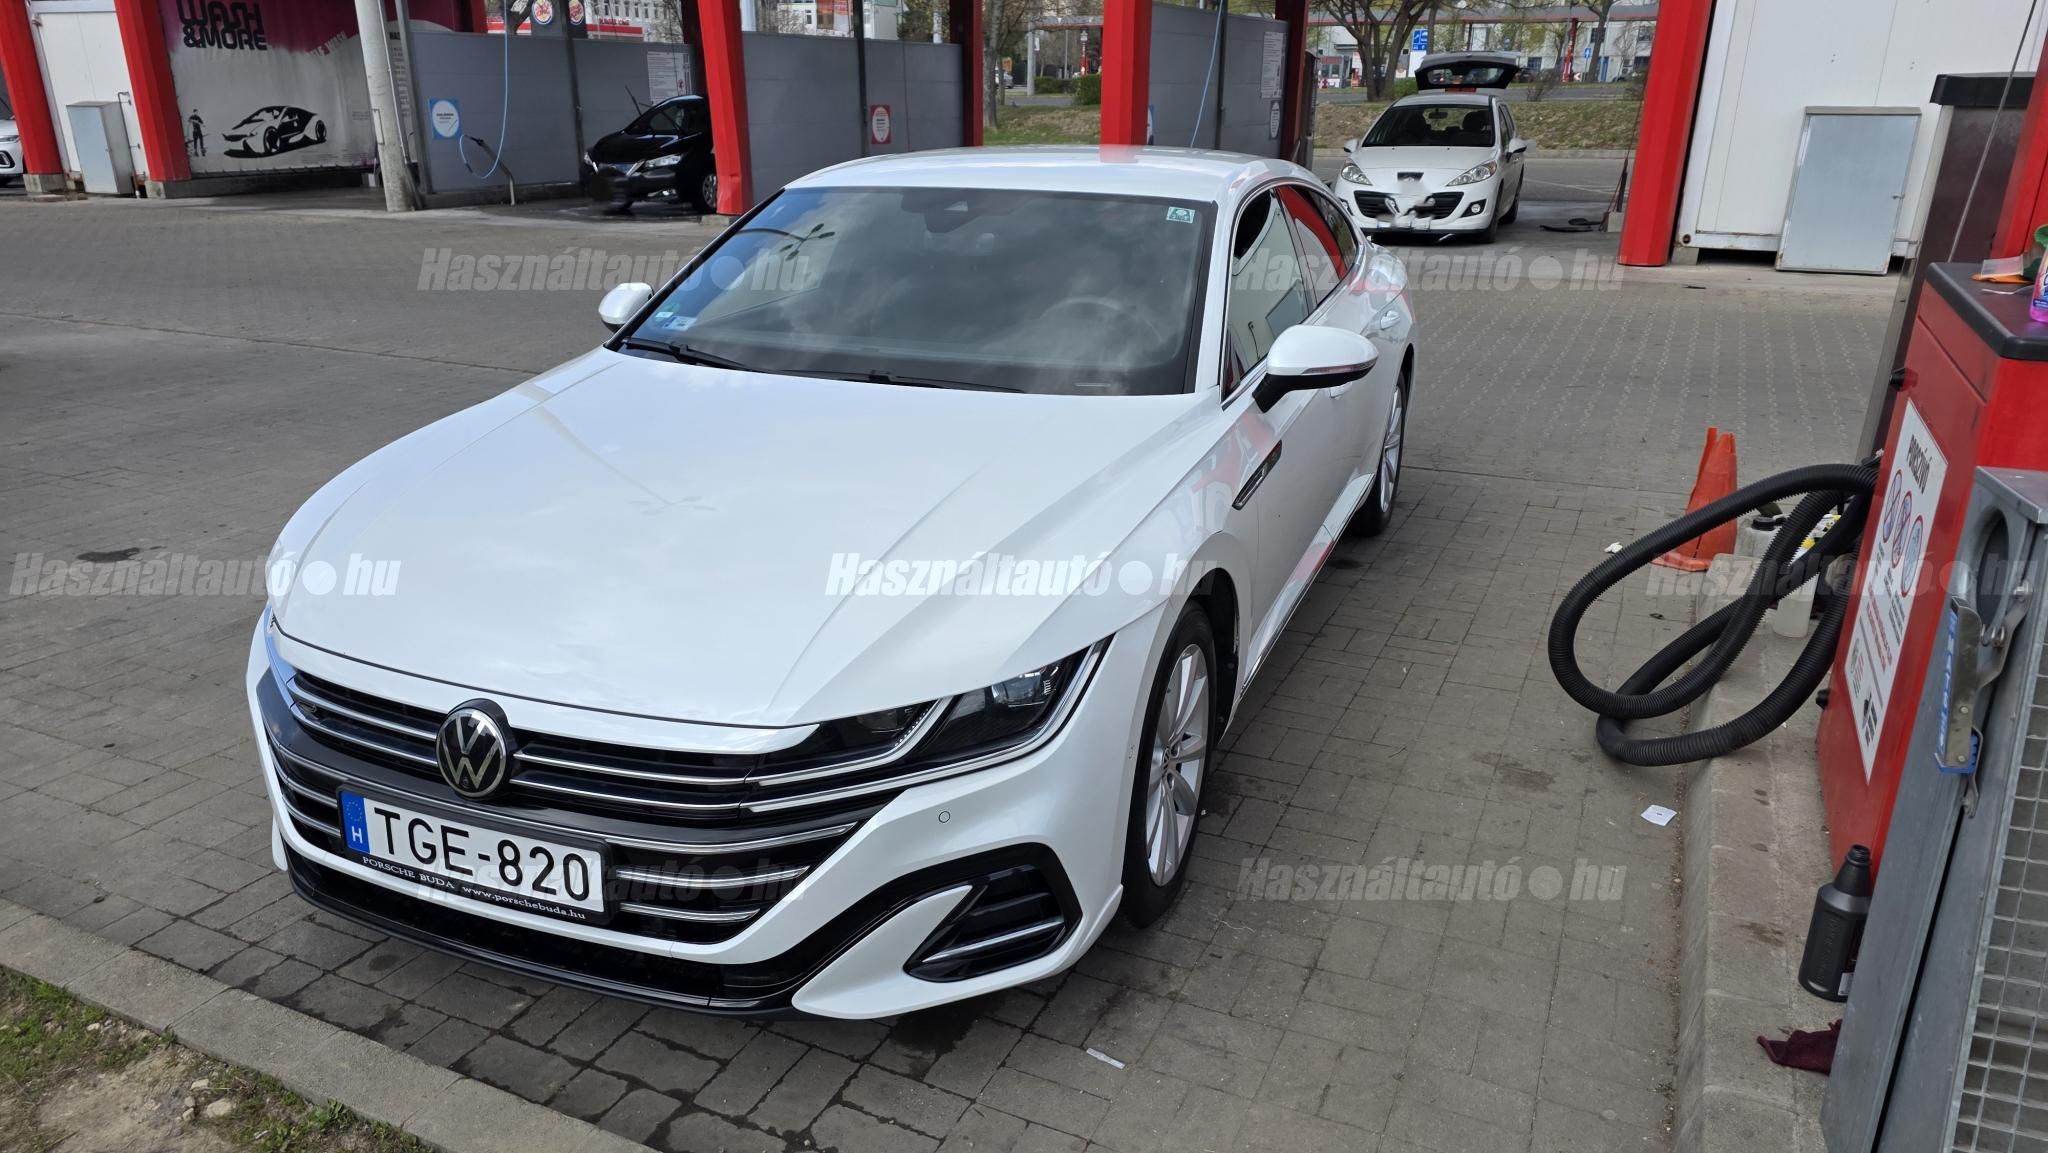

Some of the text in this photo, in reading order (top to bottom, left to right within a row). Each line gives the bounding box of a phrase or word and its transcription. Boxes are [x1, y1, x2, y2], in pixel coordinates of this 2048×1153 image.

[176, 0, 264, 33] WASH
[182, 24, 268, 50] &MORE
[351, 826, 363, 844] H
[374, 806, 590, 902] TGE-820
[362, 855, 586, 921] PORSCHE BUDA www.porschebuda.hu
